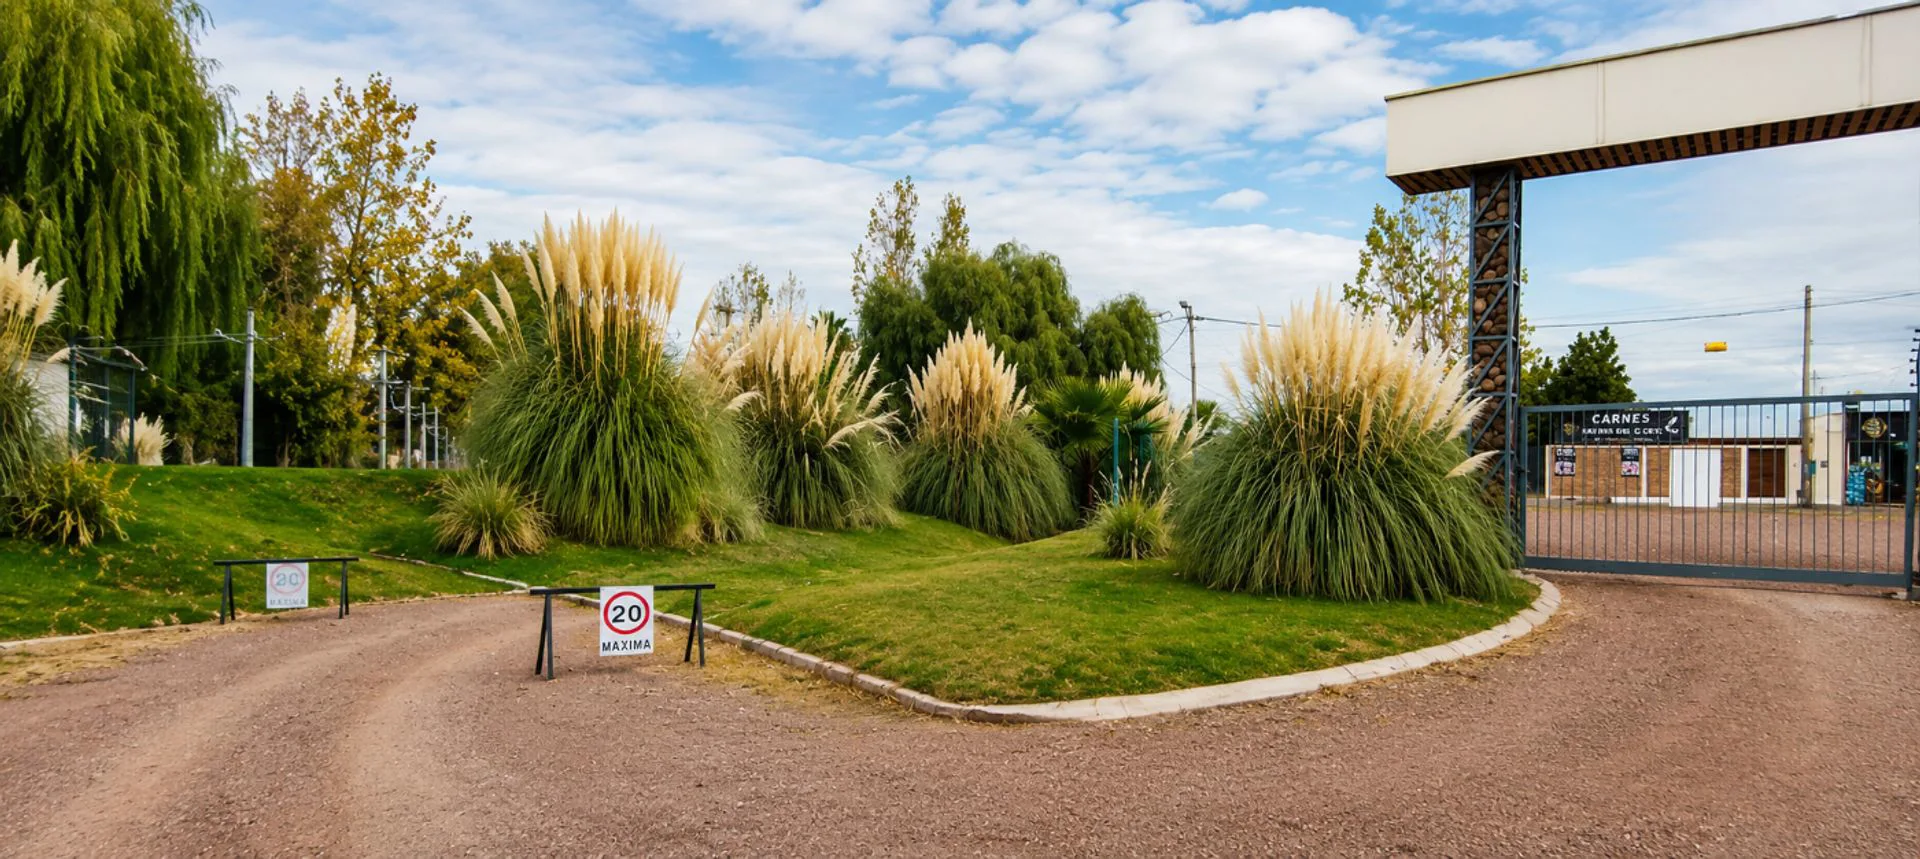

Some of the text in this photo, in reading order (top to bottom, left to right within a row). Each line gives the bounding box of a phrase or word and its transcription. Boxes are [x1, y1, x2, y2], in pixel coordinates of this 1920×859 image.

[1592, 413, 1650, 424] CARNES
[276, 572, 299, 586] 20
[612, 605, 642, 623] 20
[602, 639, 651, 652] MAXIMA
